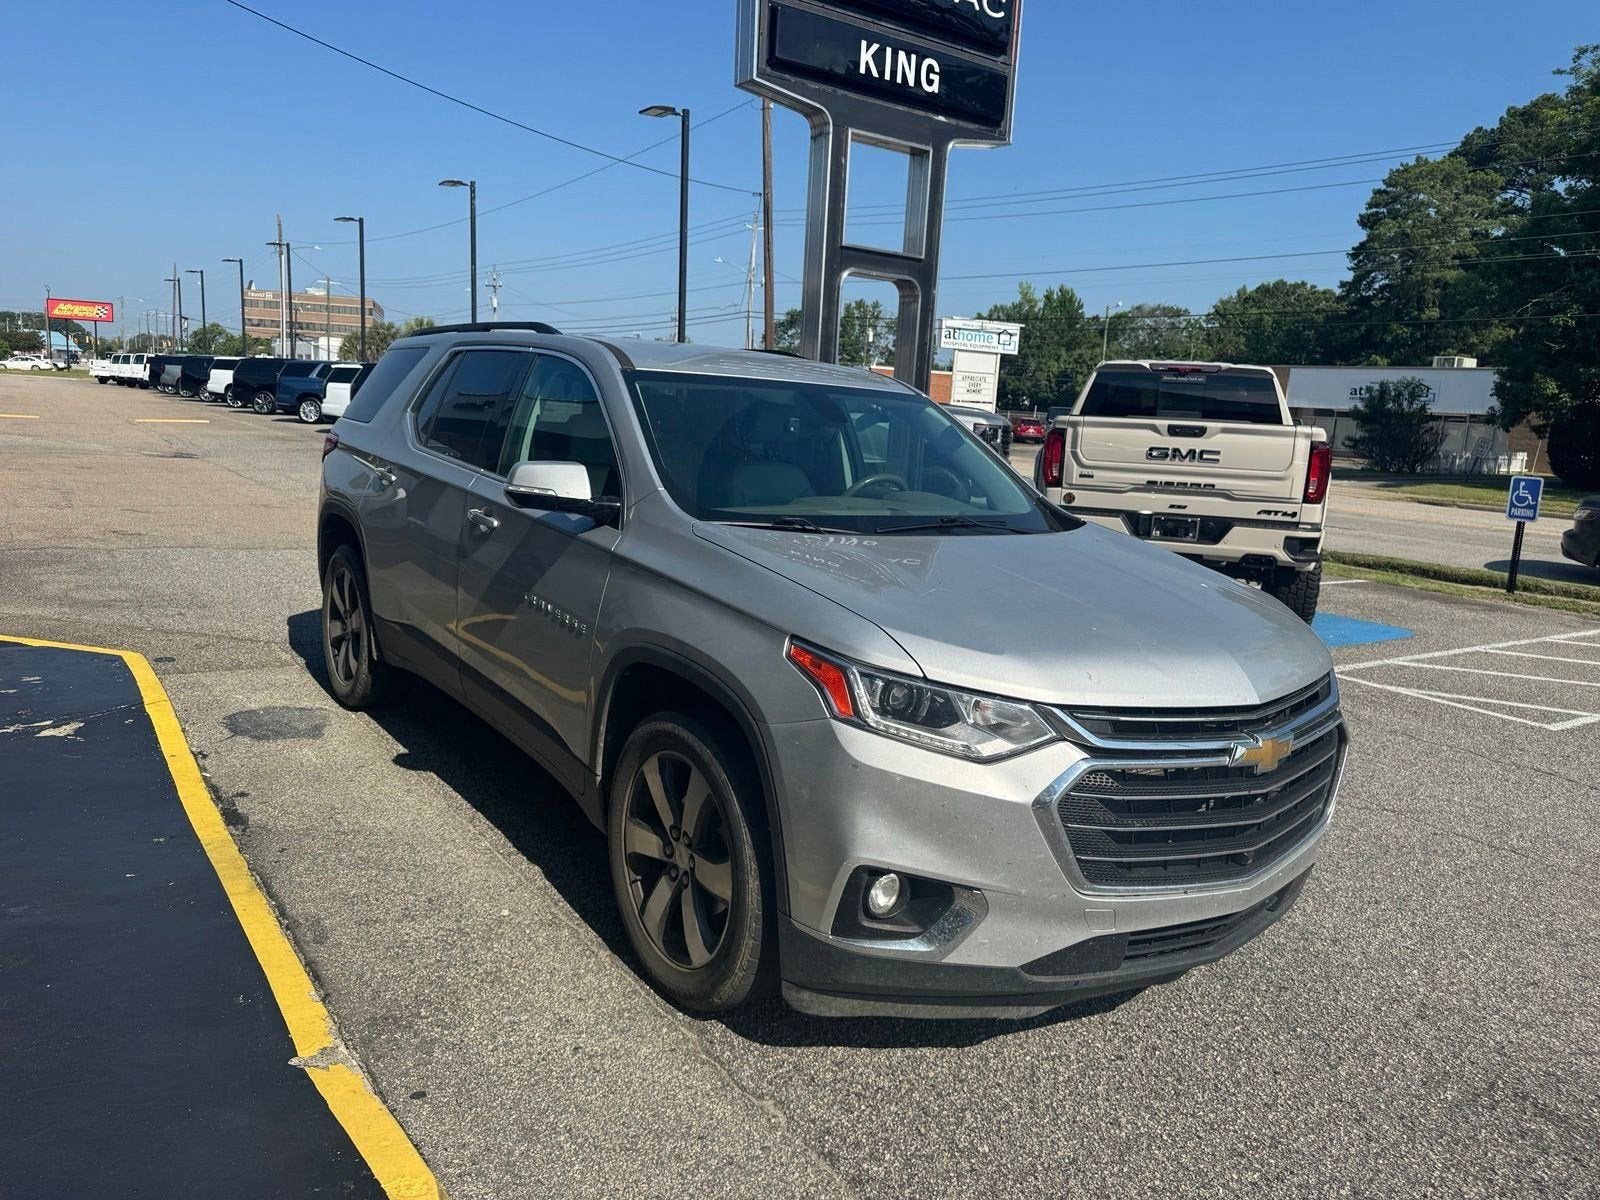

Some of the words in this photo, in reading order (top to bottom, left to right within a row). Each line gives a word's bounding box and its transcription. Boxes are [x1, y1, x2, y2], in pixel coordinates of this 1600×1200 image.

[859, 39, 940, 94] KING
[57, 302, 95, 312] Advance
[944, 328, 994, 344] athome
[969, 343, 999, 351] EQUIPMENT
[1145, 446, 1222, 464] GMC
[1256, 509, 1298, 519] AT4
[1510, 507, 1535, 518] PARKING
